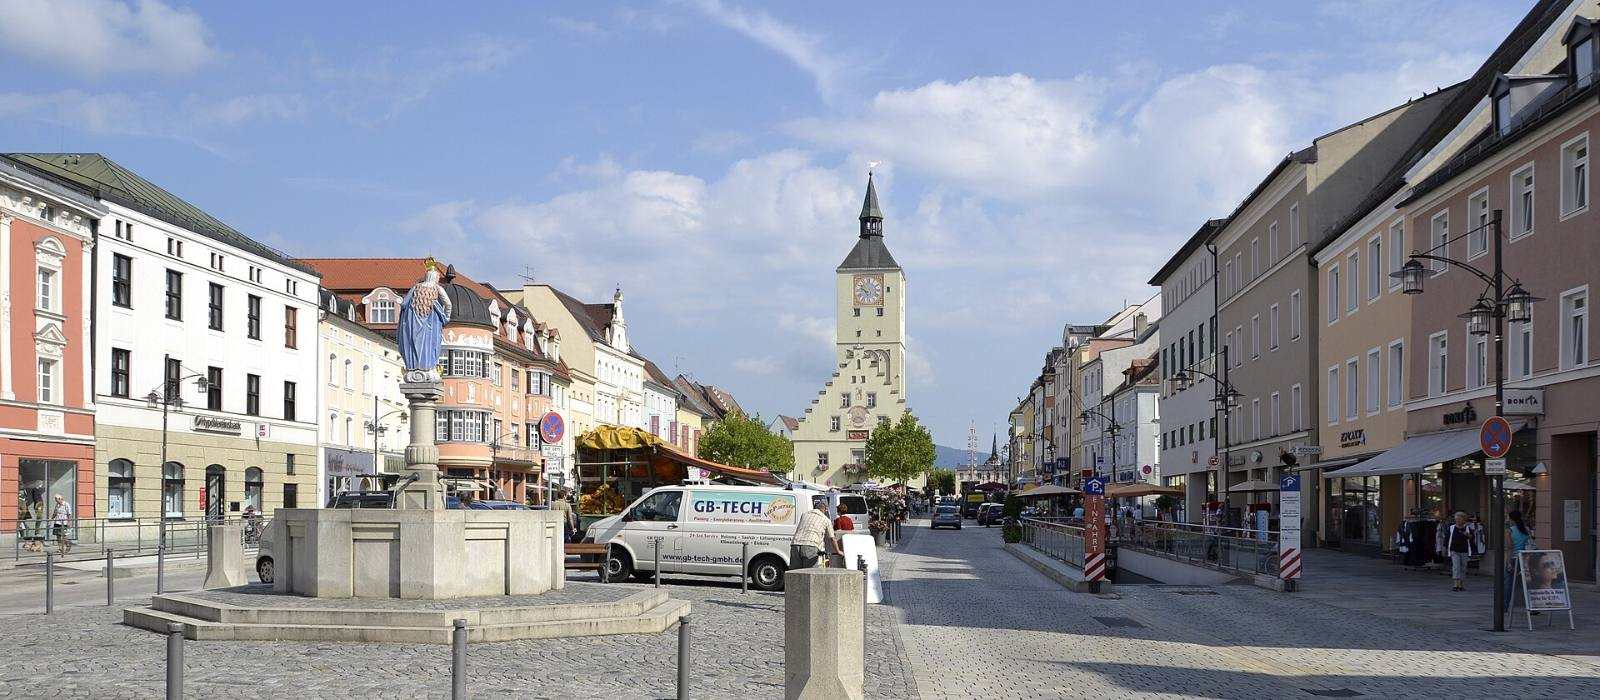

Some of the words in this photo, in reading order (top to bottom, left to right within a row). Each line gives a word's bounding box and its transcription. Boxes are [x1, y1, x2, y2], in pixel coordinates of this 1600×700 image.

[1507, 395, 1538, 407] BONITA
[693, 500, 762, 514] GB-TECH
[1091, 496, 1099, 552] EINFAHRT
[662, 553, 744, 563] www.gb-tech-gmbh.de
